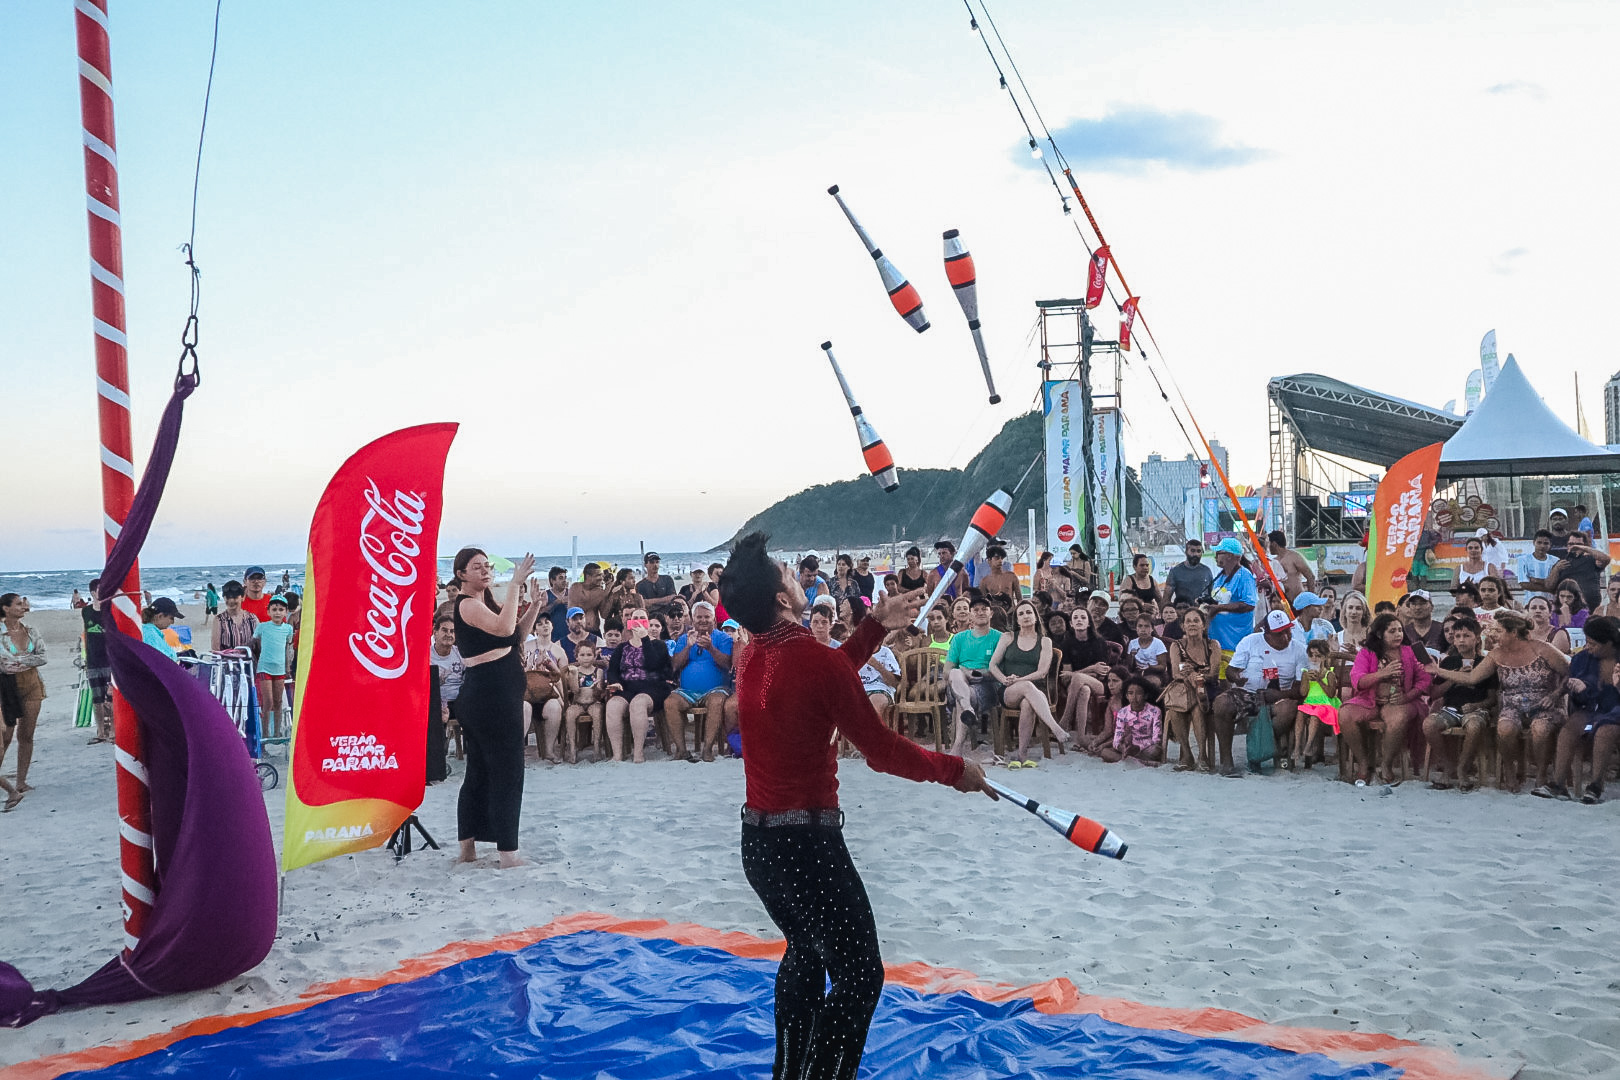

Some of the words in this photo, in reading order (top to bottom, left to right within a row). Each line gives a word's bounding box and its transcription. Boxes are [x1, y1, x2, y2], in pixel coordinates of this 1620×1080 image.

[1062, 438, 1071, 475] MAIOR
[1385, 503, 1400, 557] VERÃO
[1396, 491, 1411, 545] MAIOR
[1404, 473, 1424, 559] PARANÁ
[349, 475, 426, 680] Coca-Cola
[330, 732, 377, 748] VERÃO
[337, 744, 386, 757] MAIOR
[322, 752, 399, 772] PARANÁ
[304, 822, 374, 843] PARANÁ
